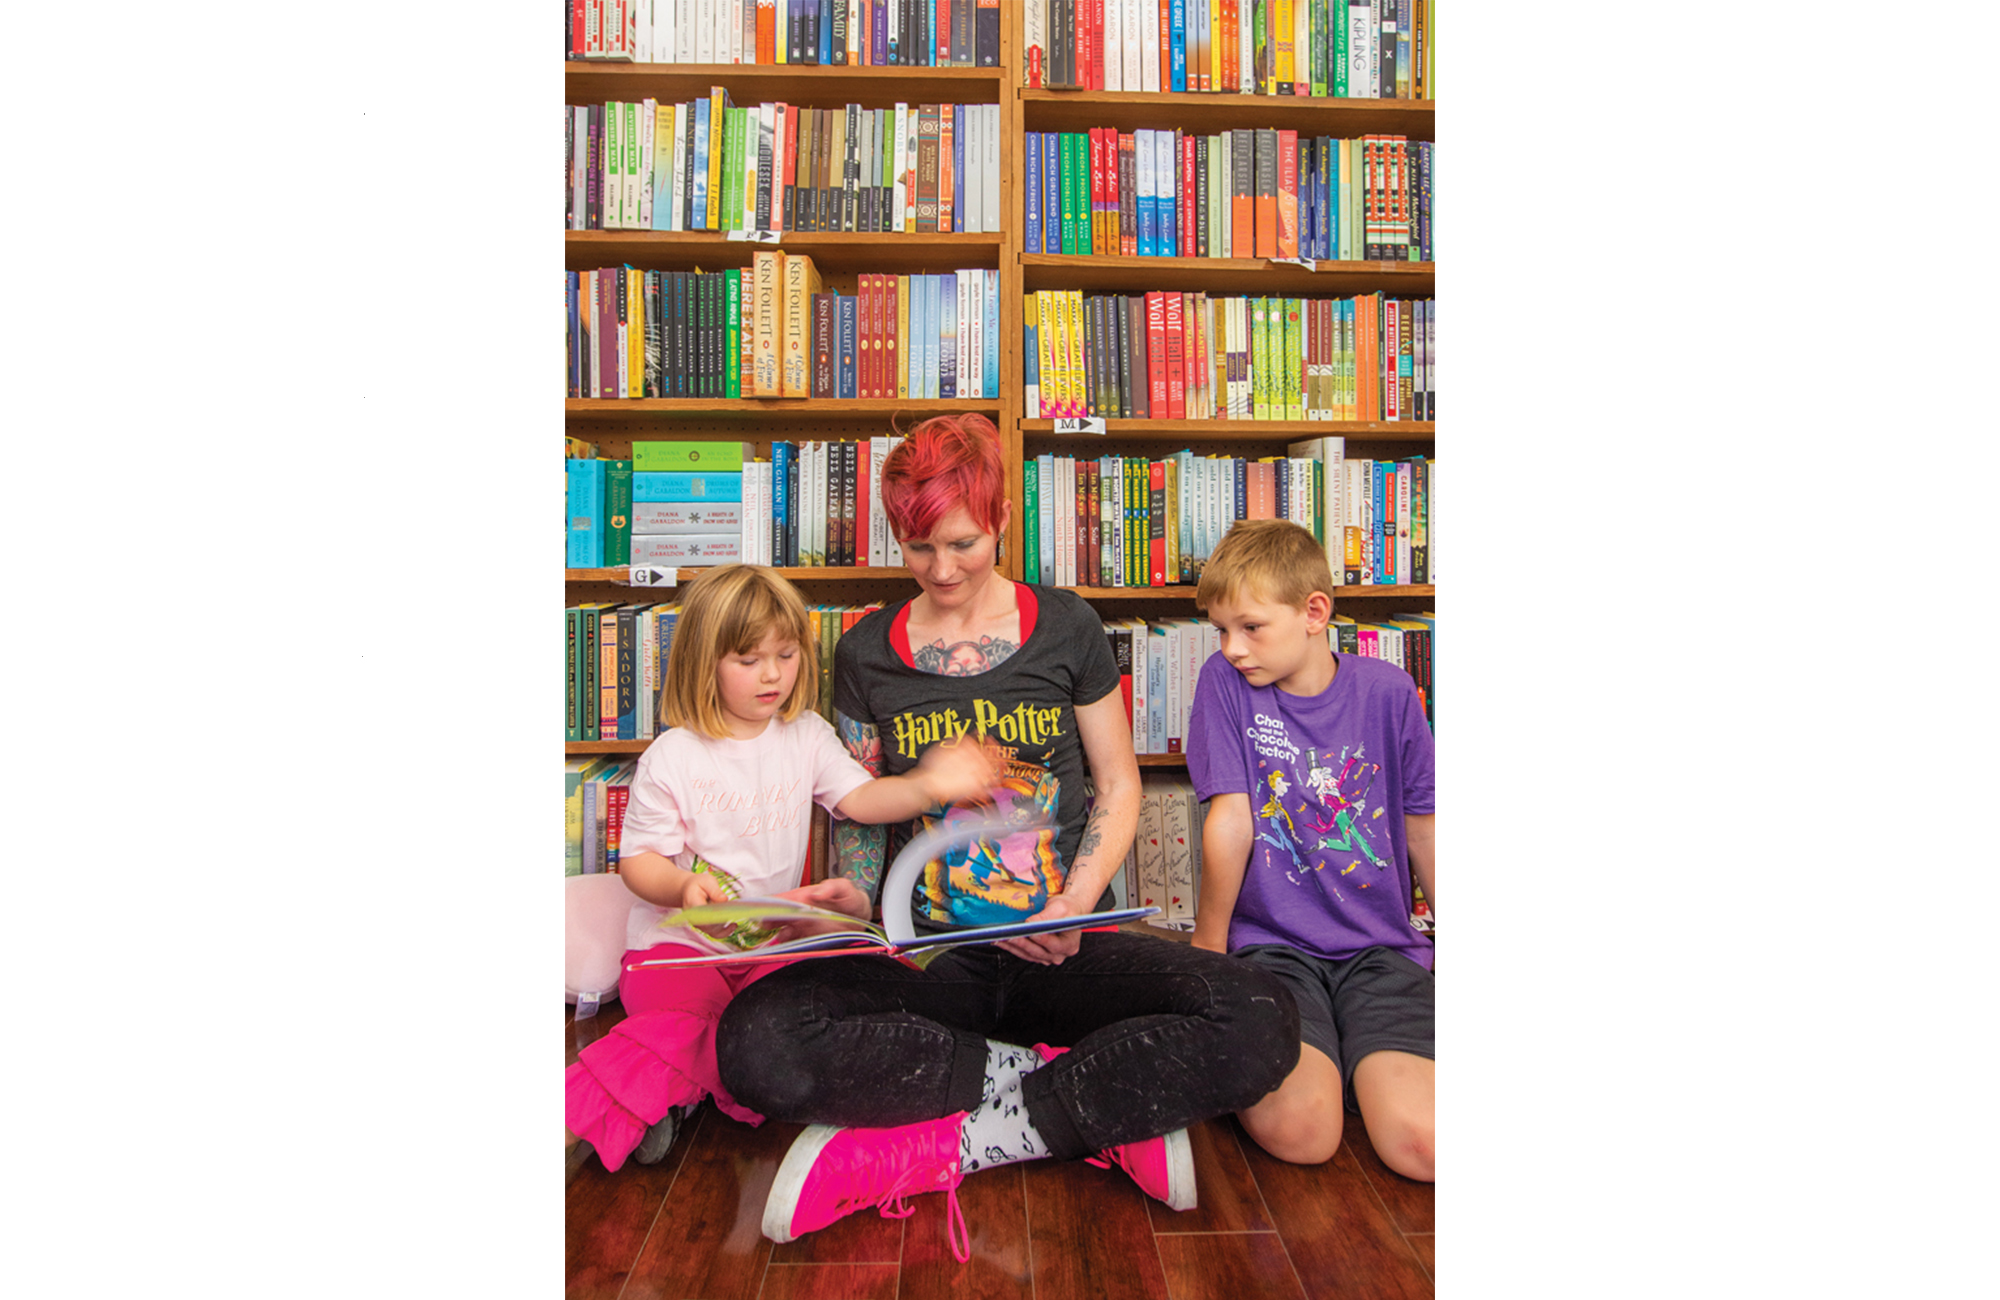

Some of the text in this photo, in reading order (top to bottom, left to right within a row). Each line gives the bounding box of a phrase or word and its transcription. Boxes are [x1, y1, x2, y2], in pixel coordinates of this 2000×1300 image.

[1128, 10, 1136, 39] KARON
[1353, 17, 1366, 71] KIPLING
[1092, 138, 1102, 193] Jhumpa Lahiri
[1106, 138, 1116, 193] Jhumpa Lahiri
[1238, 134, 1247, 189] REIF LARSEN
[1261, 134, 1271, 189] REIF LARSEN
[1285, 146, 1293, 245] THE ILIAD OF HOMER
[1409, 196, 1419, 240] Mockingbird
[742, 272, 753, 354] HERE I AM
[760, 260, 772, 337] KEN FOLLETT
[790, 261, 801, 338] KEN FOLLETT
[820, 299, 828, 352] KEN FOLLETT
[1150, 297, 1164, 363] Wolf Hall
[1168, 297, 1181, 363] Wolf Hall
[1401, 315, 1409, 355] REBECCA
[756, 365, 765, 382] Fire
[925, 345, 933, 377] FORD
[940, 342, 948, 376] FORD
[1060, 419, 1076, 429] M
[845, 446, 854, 518] NEIL GAIMAN
[1182, 496, 1190, 526] monday
[635, 570, 647, 583] G
[620, 628, 630, 708] ISADORA
[1170, 634, 1178, 658] Three
[893, 707, 971, 759] Harry
[1254, 741, 1296, 764] Factory
[1164, 798, 1186, 816] Letters
